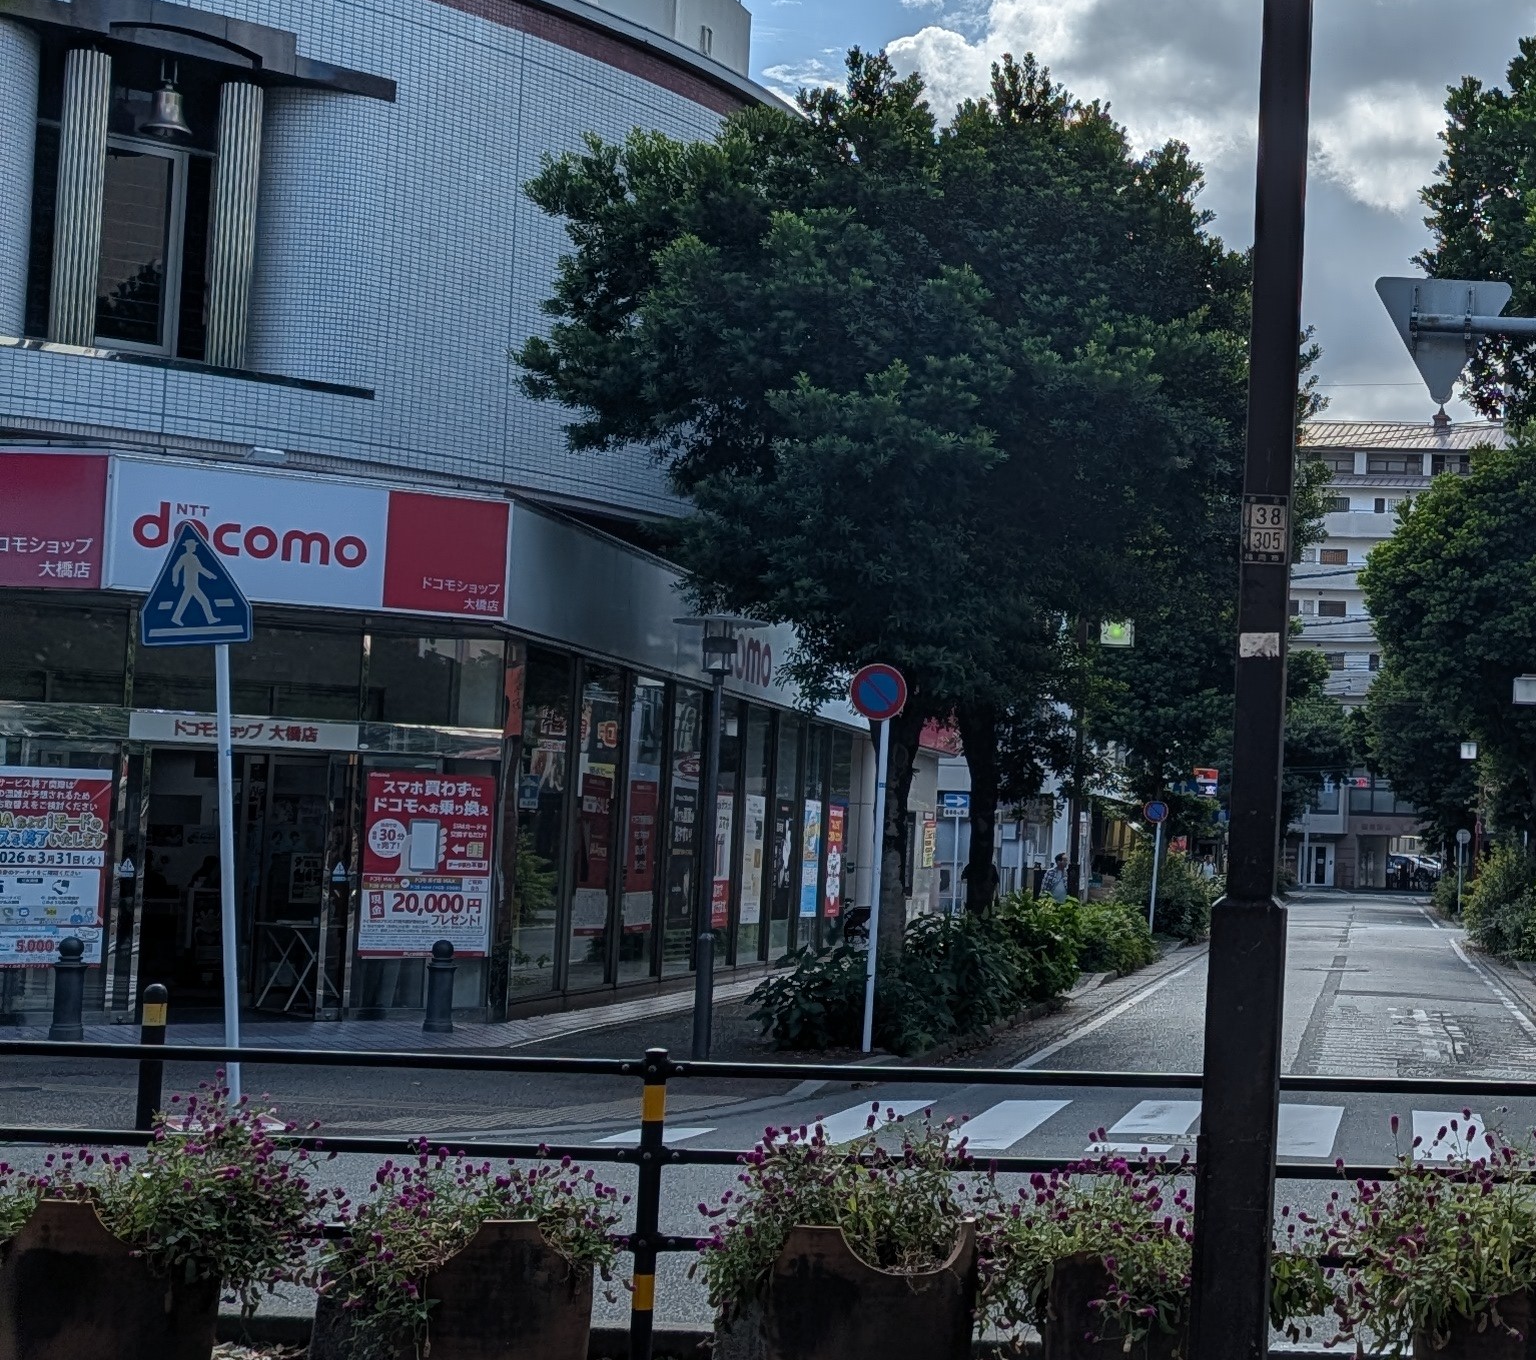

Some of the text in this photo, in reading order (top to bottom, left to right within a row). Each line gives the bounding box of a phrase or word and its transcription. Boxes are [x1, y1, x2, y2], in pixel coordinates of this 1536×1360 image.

[176, 502, 210, 517] NTT
[1256, 507, 1281, 525] 38
[1253, 531, 1281, 550] 305
[38, 561, 91, 578] 大橋店
[421, 576, 500, 595] ドコモショップ
[463, 597, 499, 612] 大橋店
[174, 719, 319, 743] ドコモョップ 大橋店
[383, 780, 482, 797] スマホ買わずに
[373, 797, 489, 817] ドコモへお乗り換え
[0, 812, 103, 831] Aおよびiモードの
[392, 892, 482, 916] 20,000円
[431, 914, 480, 926] プレゼント!
